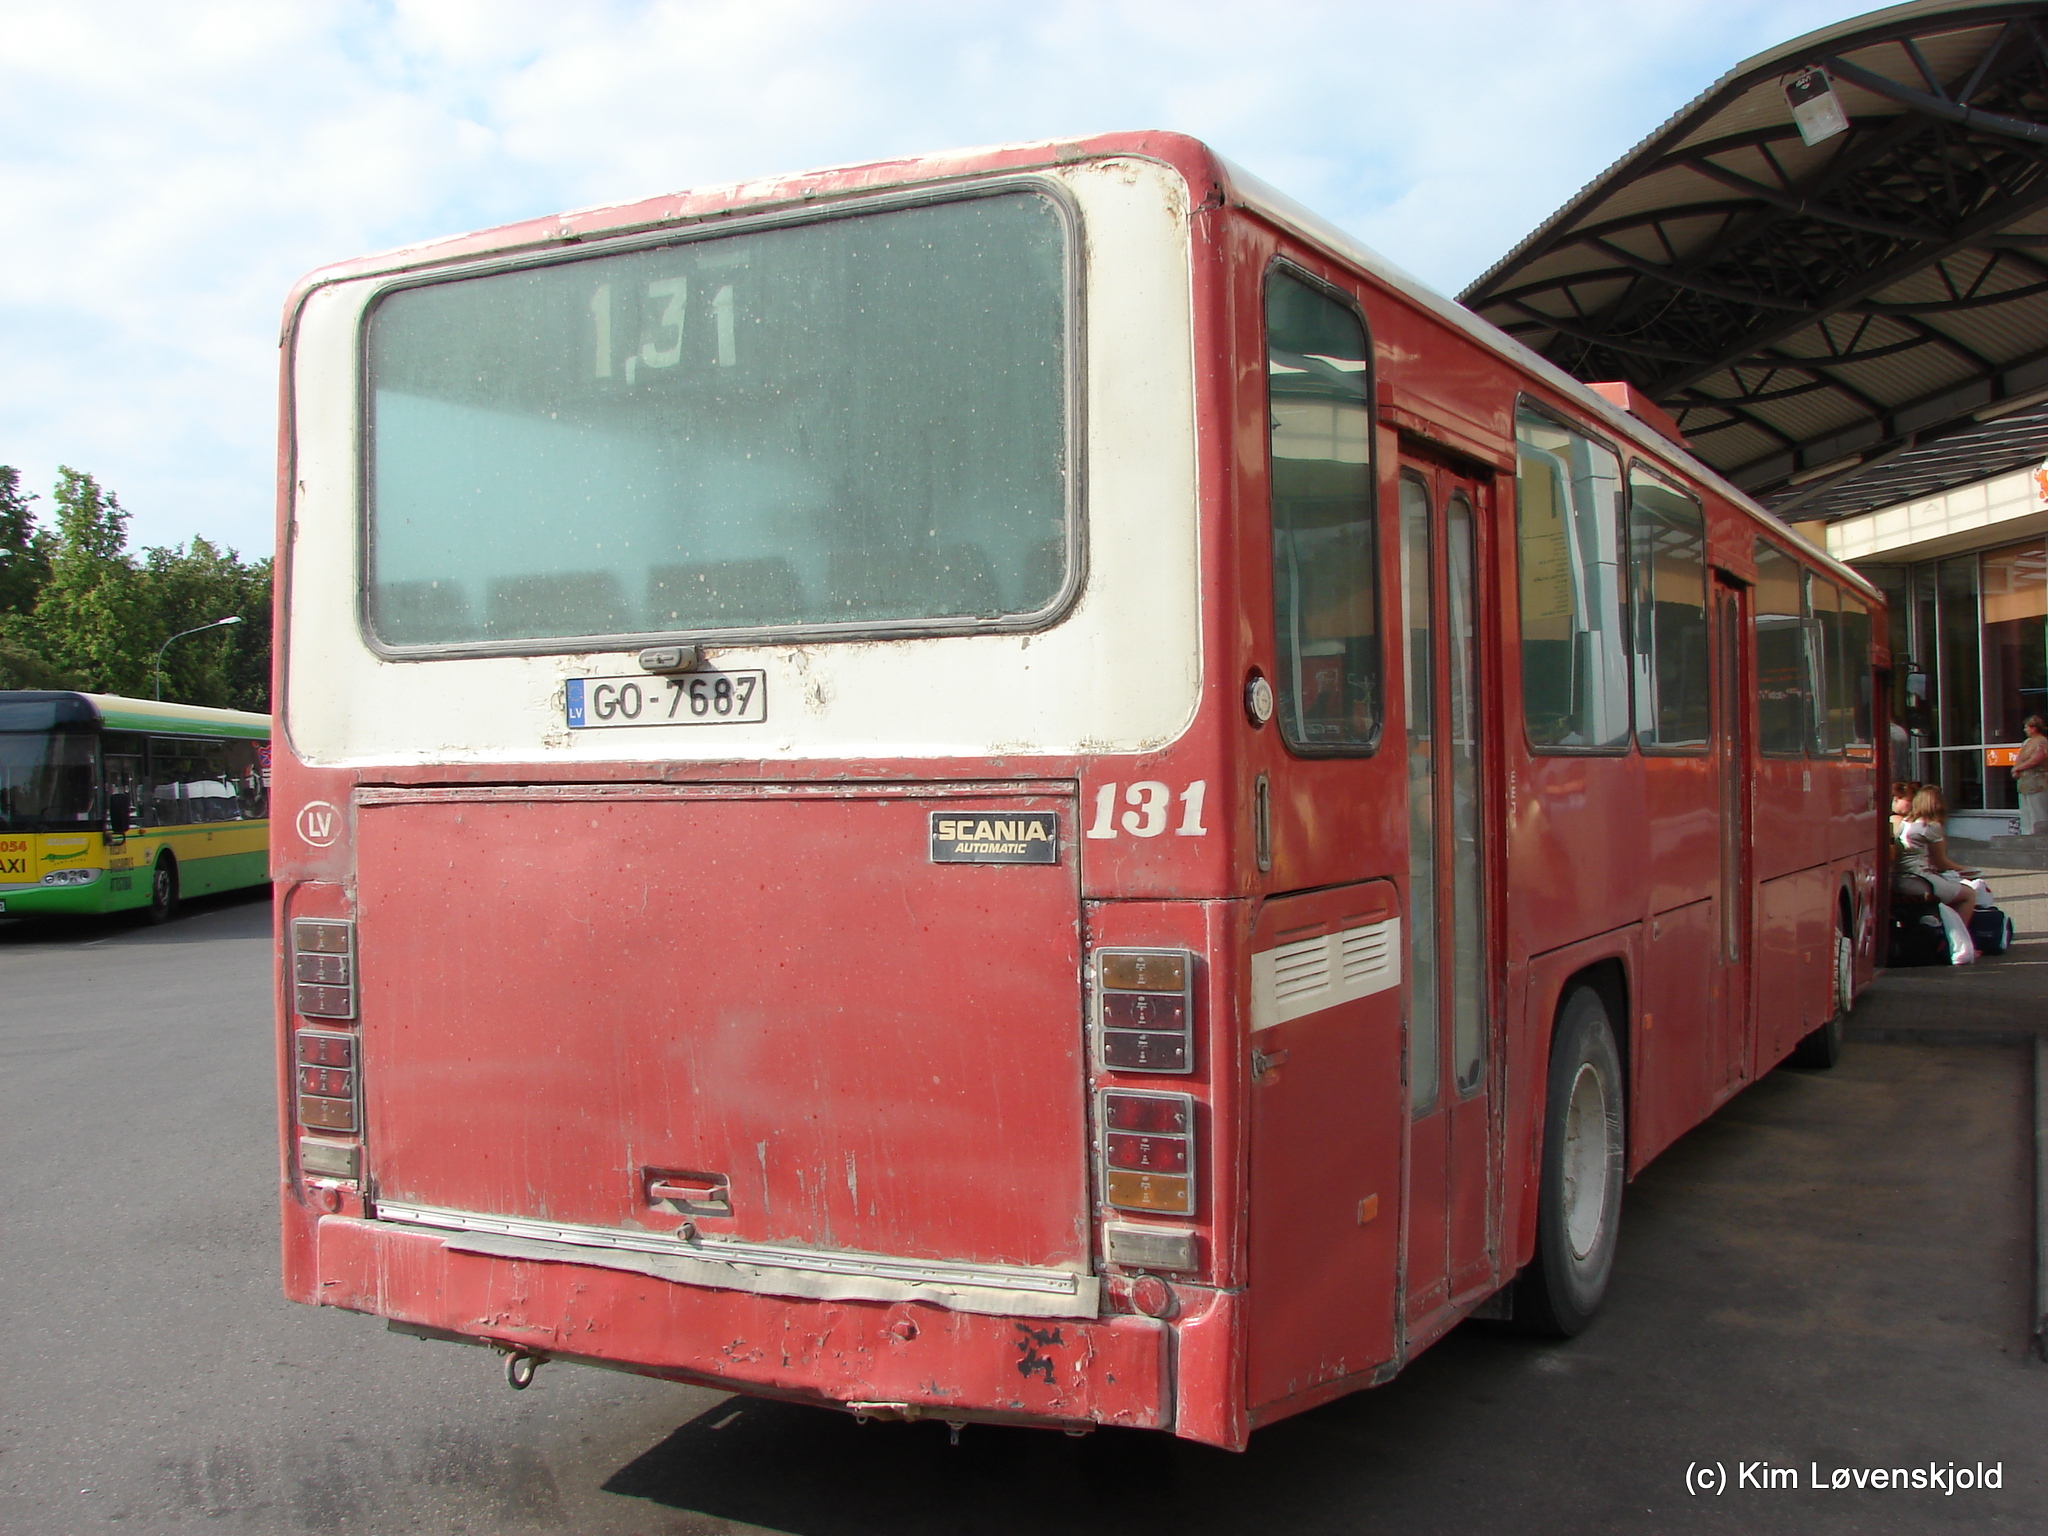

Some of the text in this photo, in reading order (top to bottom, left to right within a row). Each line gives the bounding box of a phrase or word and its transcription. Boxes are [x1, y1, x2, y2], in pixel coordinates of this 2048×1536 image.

[593, 676, 757, 720] GO-7687
[569, 707, 583, 719] LV
[1086, 780, 1208, 839] 131
[308, 811, 332, 838] LV
[939, 820, 1047, 841] SCANIA
[954, 842, 1027, 854] AUTOMATIC
